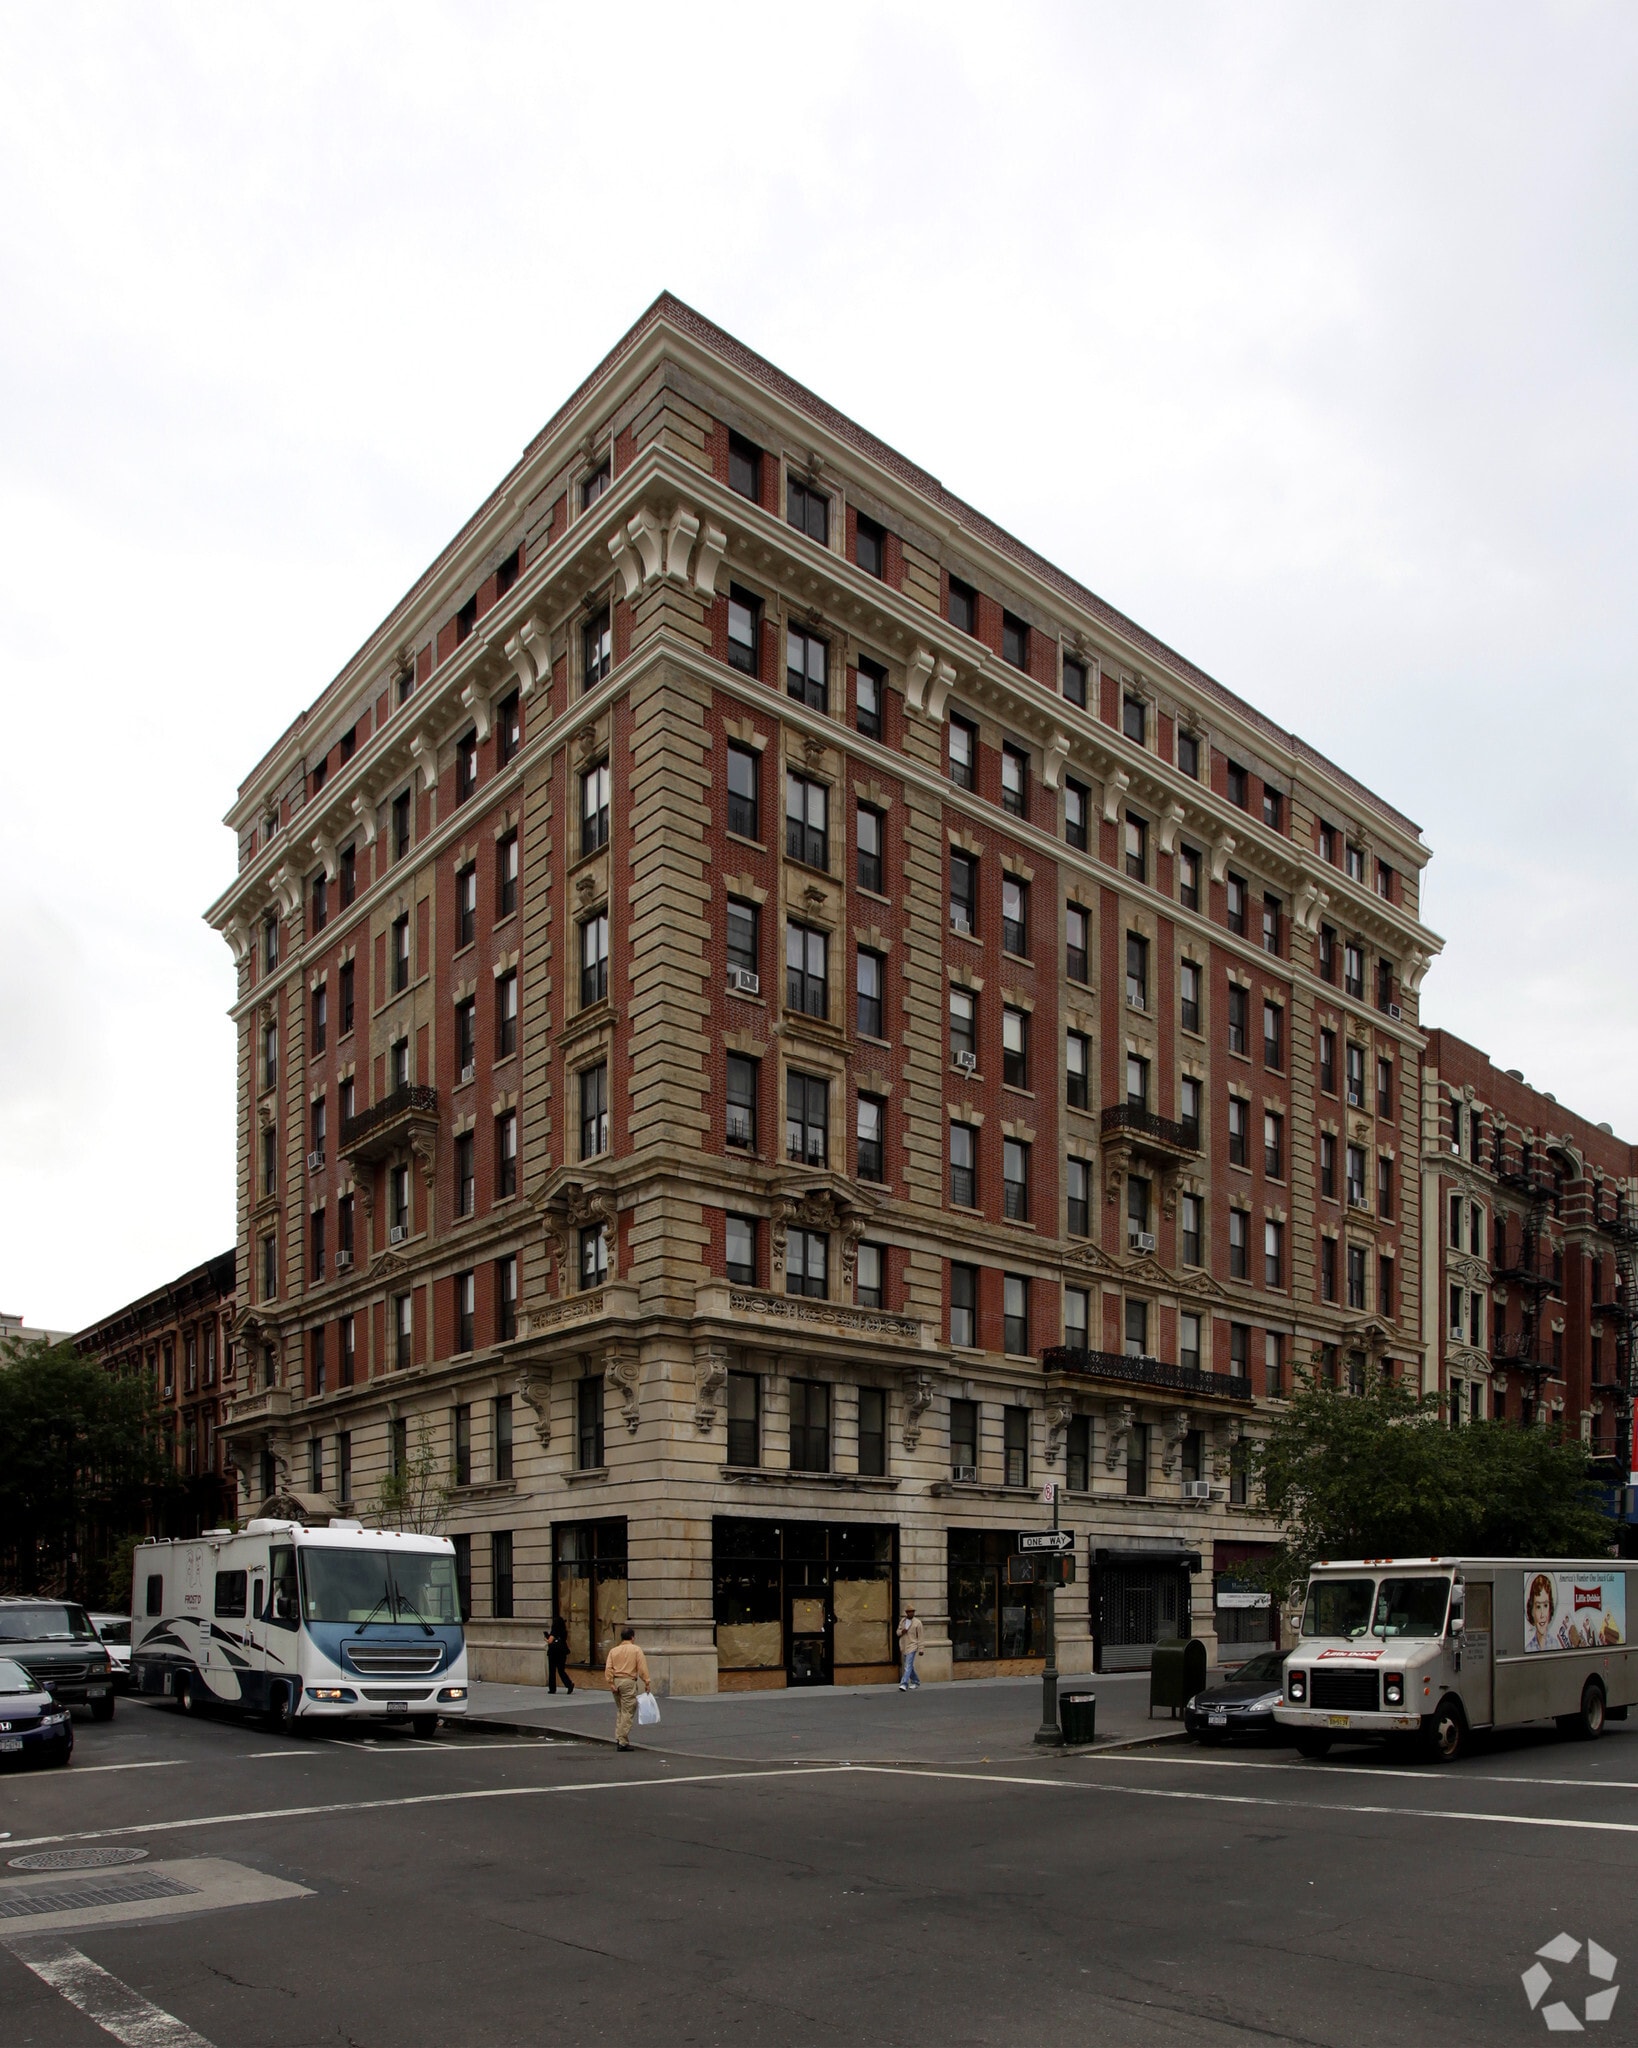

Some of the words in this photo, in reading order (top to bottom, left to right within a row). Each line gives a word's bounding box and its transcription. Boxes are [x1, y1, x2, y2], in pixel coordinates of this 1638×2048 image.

[1027, 1537, 1042, 1546] ONE
[1050, 1536, 1066, 1545] WAY
[1576, 1594, 1586, 1603] Little
[1586, 1593, 1601, 1603] Debbie
